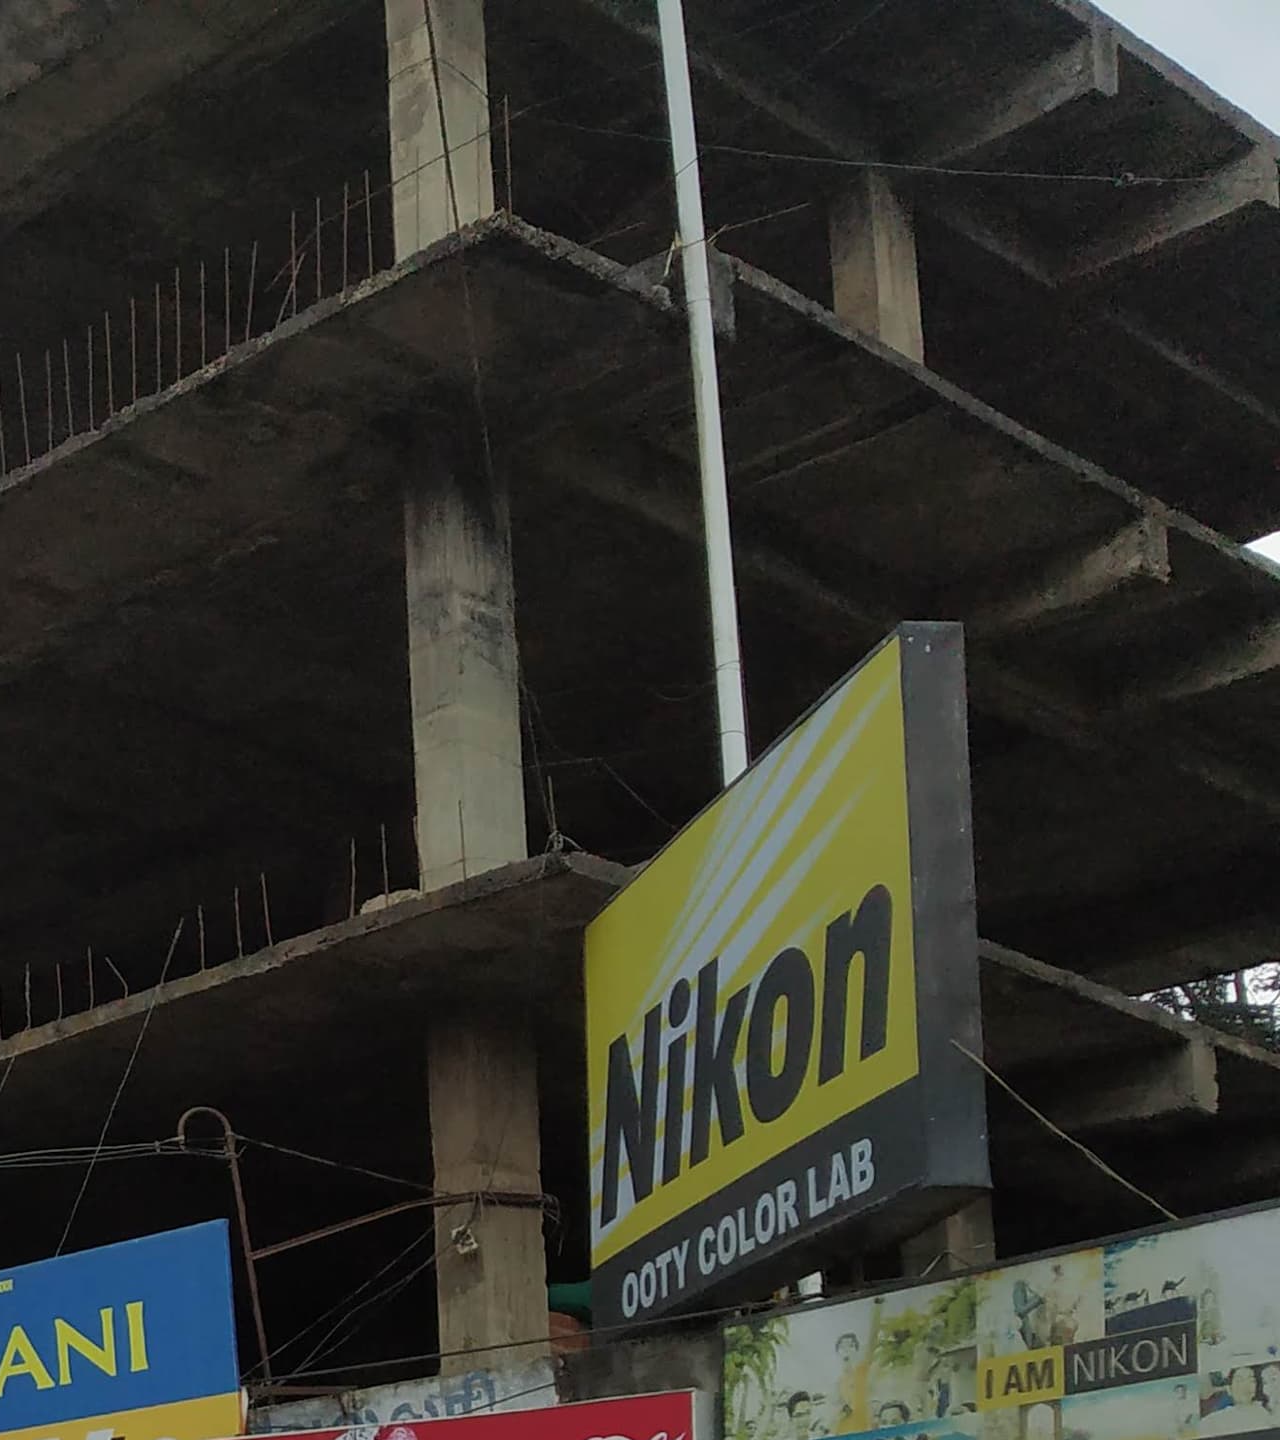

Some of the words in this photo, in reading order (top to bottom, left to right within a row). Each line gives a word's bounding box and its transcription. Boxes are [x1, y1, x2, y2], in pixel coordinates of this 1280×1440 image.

[599, 883, 893, 1230] Nikon
[620, 1238, 689, 1320] OOTY
[697, 1178, 800, 1276] COLOR
[807, 1137, 876, 1221] LAB
[984, 1368, 994, 1399] I
[1002, 1358, 1055, 1394] AM
[1071, 1333, 1189, 1384] NIKON
